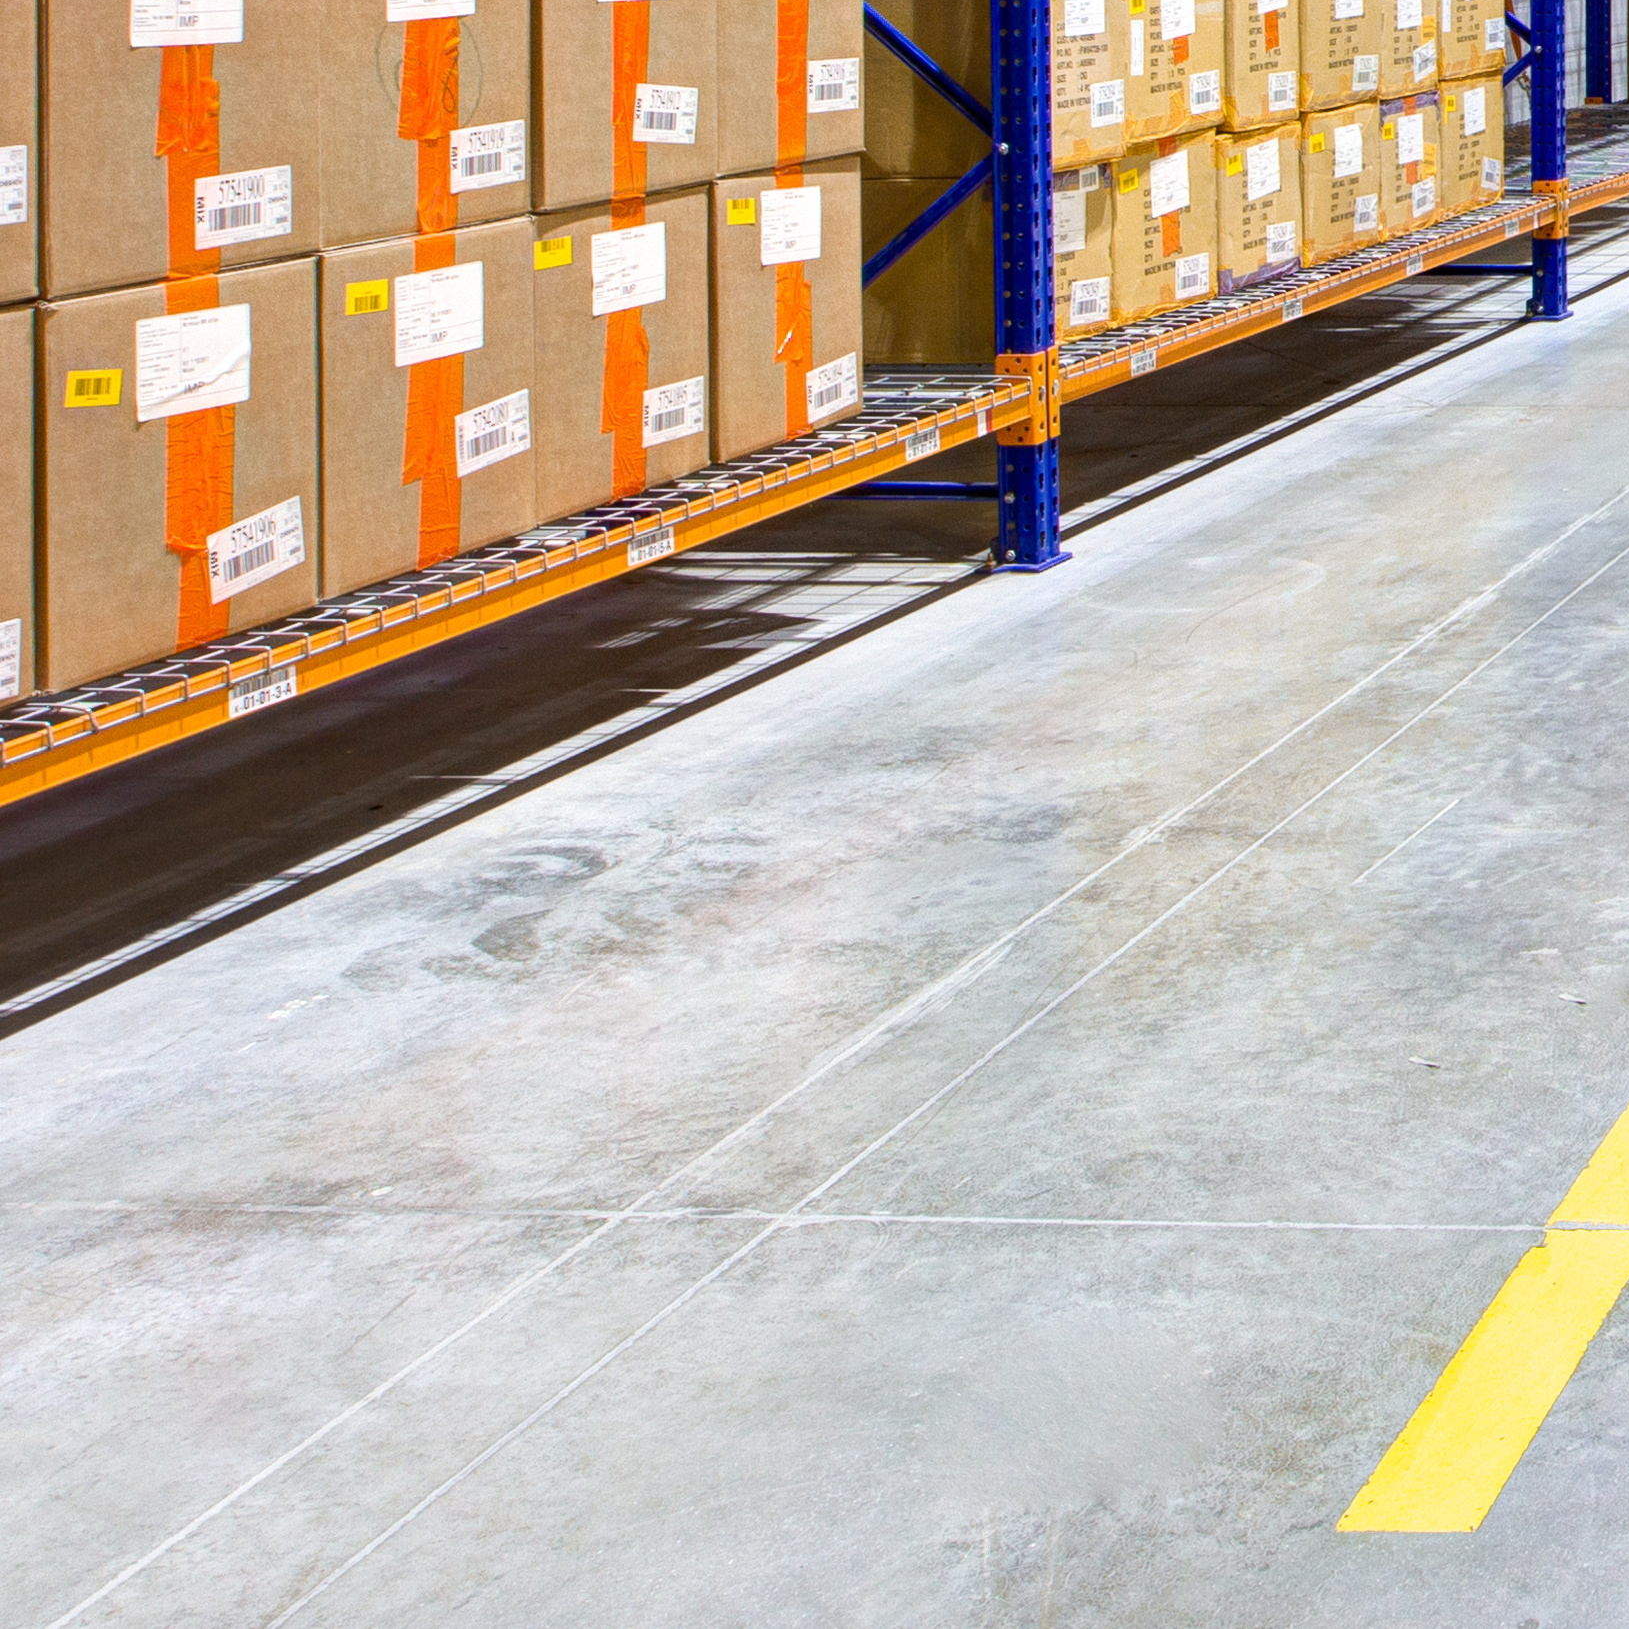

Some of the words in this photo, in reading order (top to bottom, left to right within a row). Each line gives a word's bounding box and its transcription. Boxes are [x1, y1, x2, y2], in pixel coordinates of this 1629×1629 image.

[179, 15, 200, 28] IMP
[218, 174, 265, 206] 57541900
[230, 512, 277, 554] 57541906
